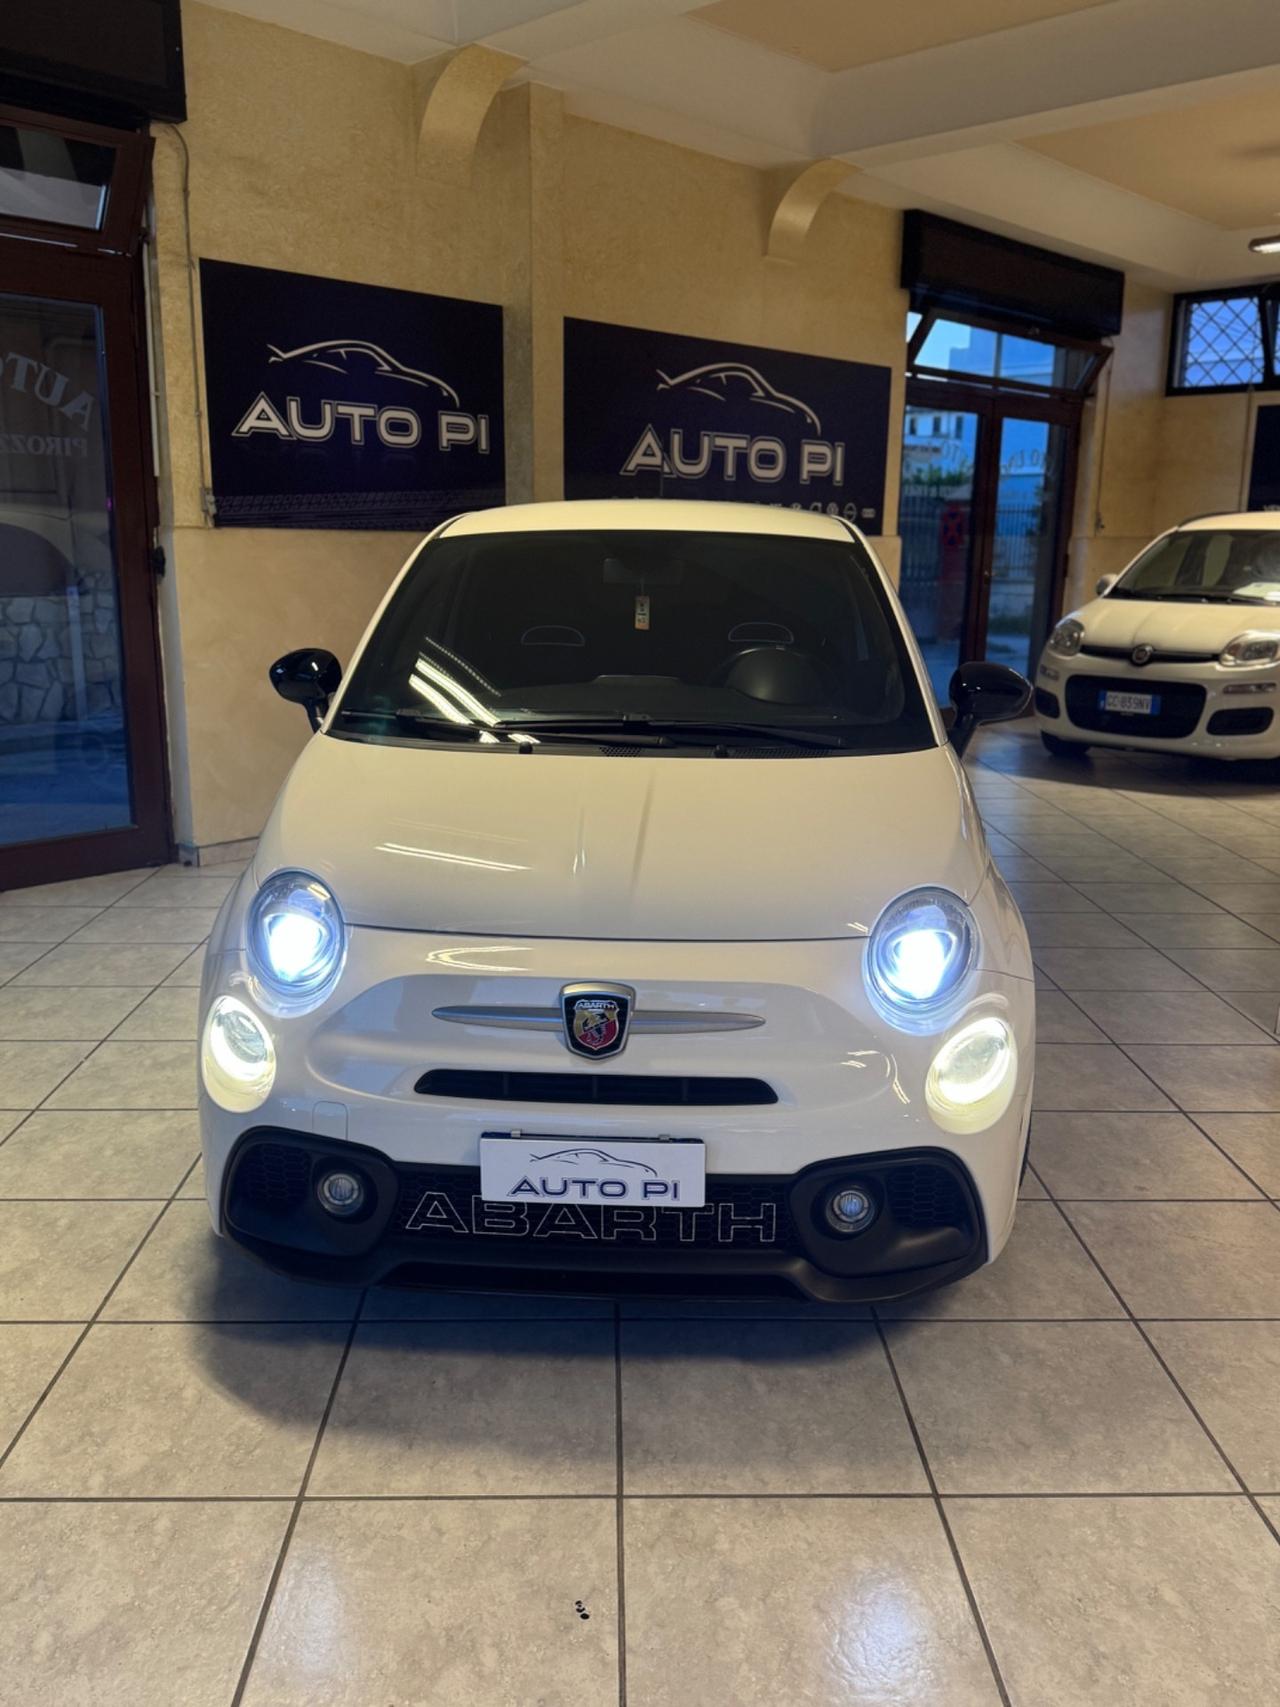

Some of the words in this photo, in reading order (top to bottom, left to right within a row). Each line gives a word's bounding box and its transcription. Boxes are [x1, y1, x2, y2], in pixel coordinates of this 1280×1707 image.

[231, 391, 422, 448] AUTO
[438, 411, 489, 454] PI
[619, 423, 787, 482] AUTO
[800, 439, 845, 486] PI
[405, 1191, 776, 1242] ABARTH
[507, 1175, 628, 1199] AUTO
[643, 1179, 681, 1201] PI
